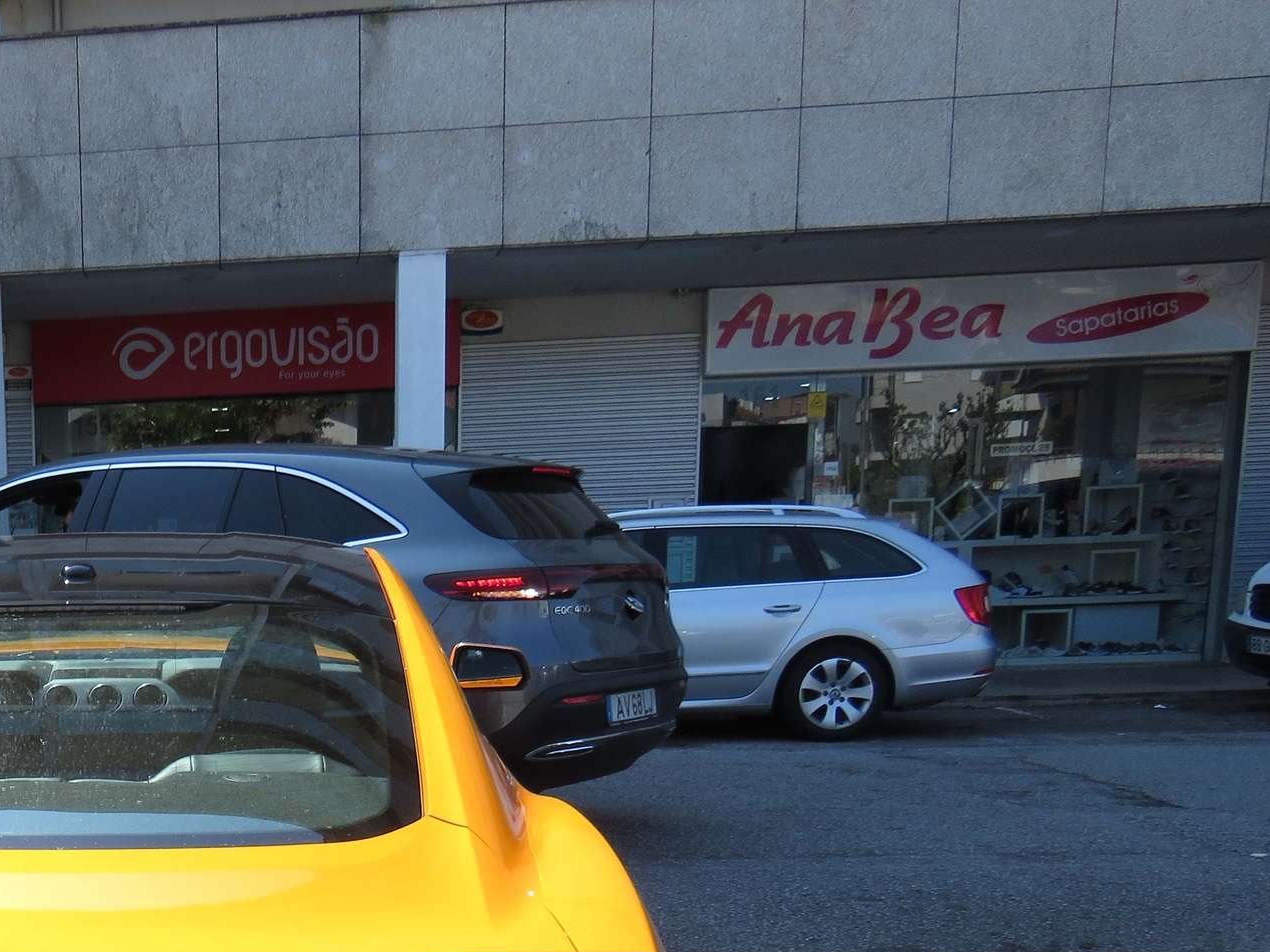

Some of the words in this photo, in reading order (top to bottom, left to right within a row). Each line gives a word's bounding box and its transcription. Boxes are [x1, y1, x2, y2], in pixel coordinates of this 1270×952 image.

[1055, 299, 1180, 338] Sapatarias
[183, 316, 379, 379] ergovisão
[278, 370, 295, 380] For
[298, 370, 320, 381] your
[323, 369, 346, 380] eyes
[554, 605, 573, 616] EQC
[574, 604, 591, 614] 400
